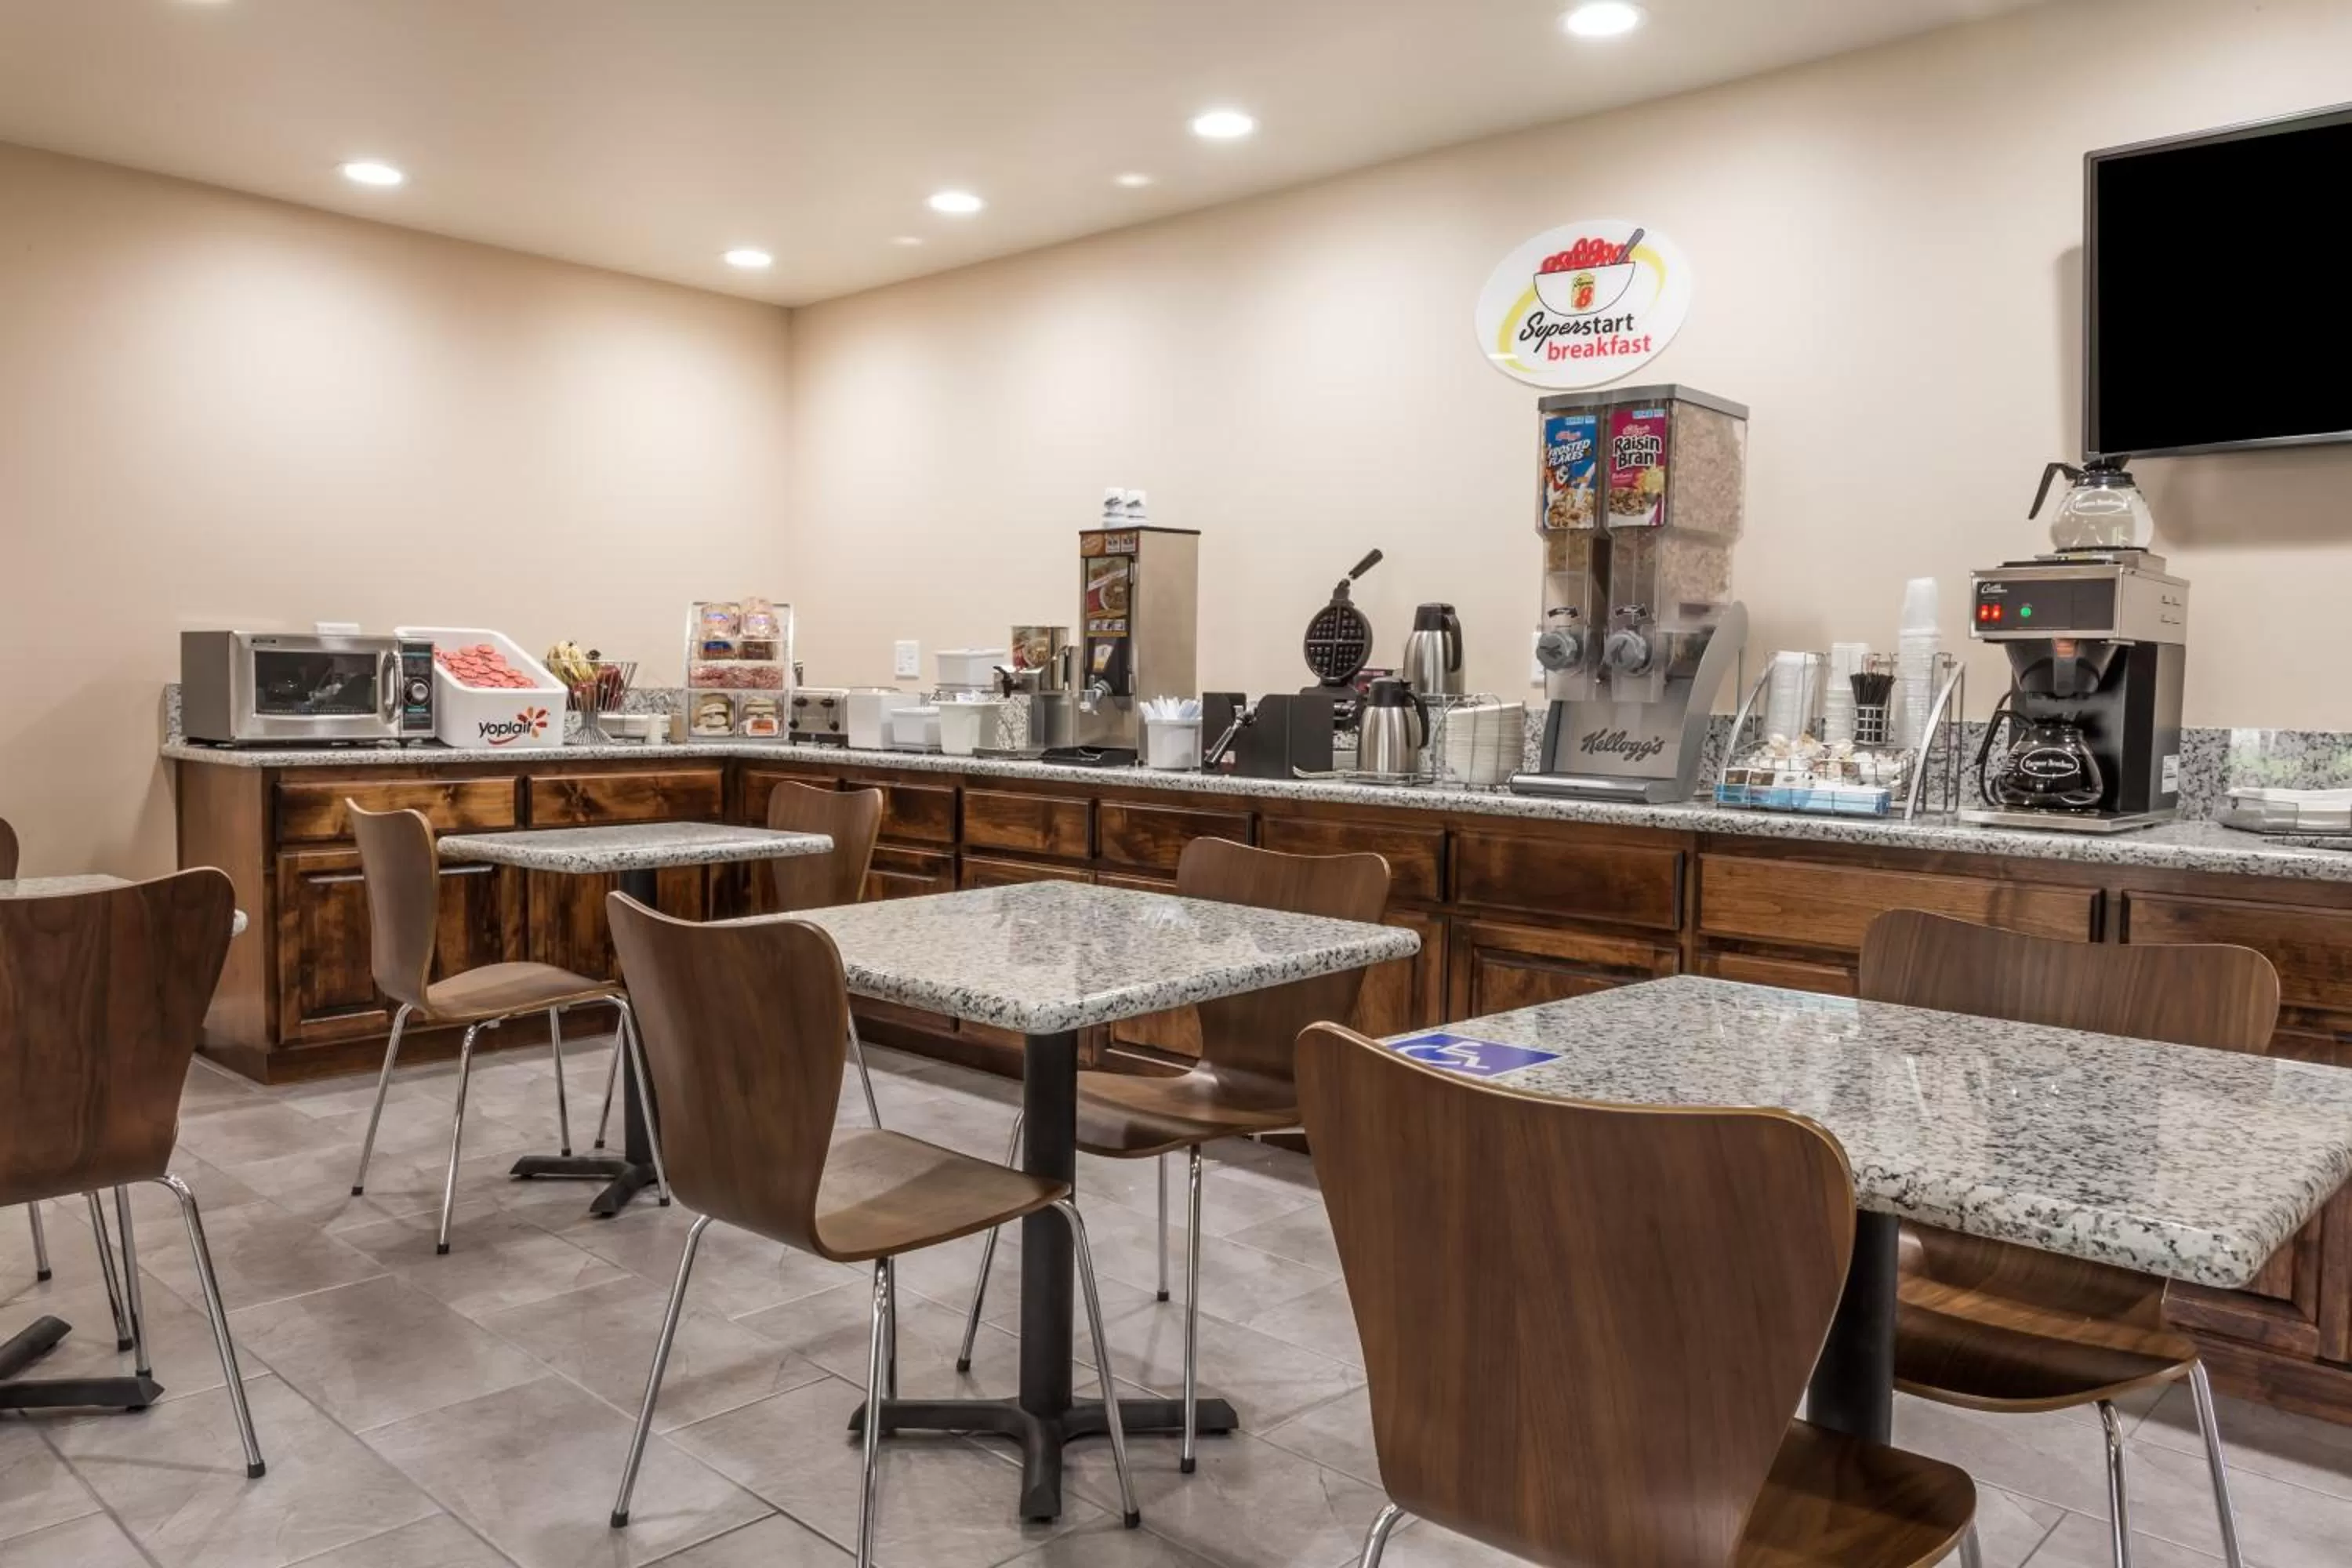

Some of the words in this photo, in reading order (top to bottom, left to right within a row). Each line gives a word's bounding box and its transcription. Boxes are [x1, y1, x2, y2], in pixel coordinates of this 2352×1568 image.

[1519, 311, 1635, 353] Superstart
[1547, 335, 1652, 361] breakfast
[1614, 435, 1661, 456] Raisin
[1617, 451, 1655, 469] Bran
[1580, 728, 1665, 762] Kellogg's
